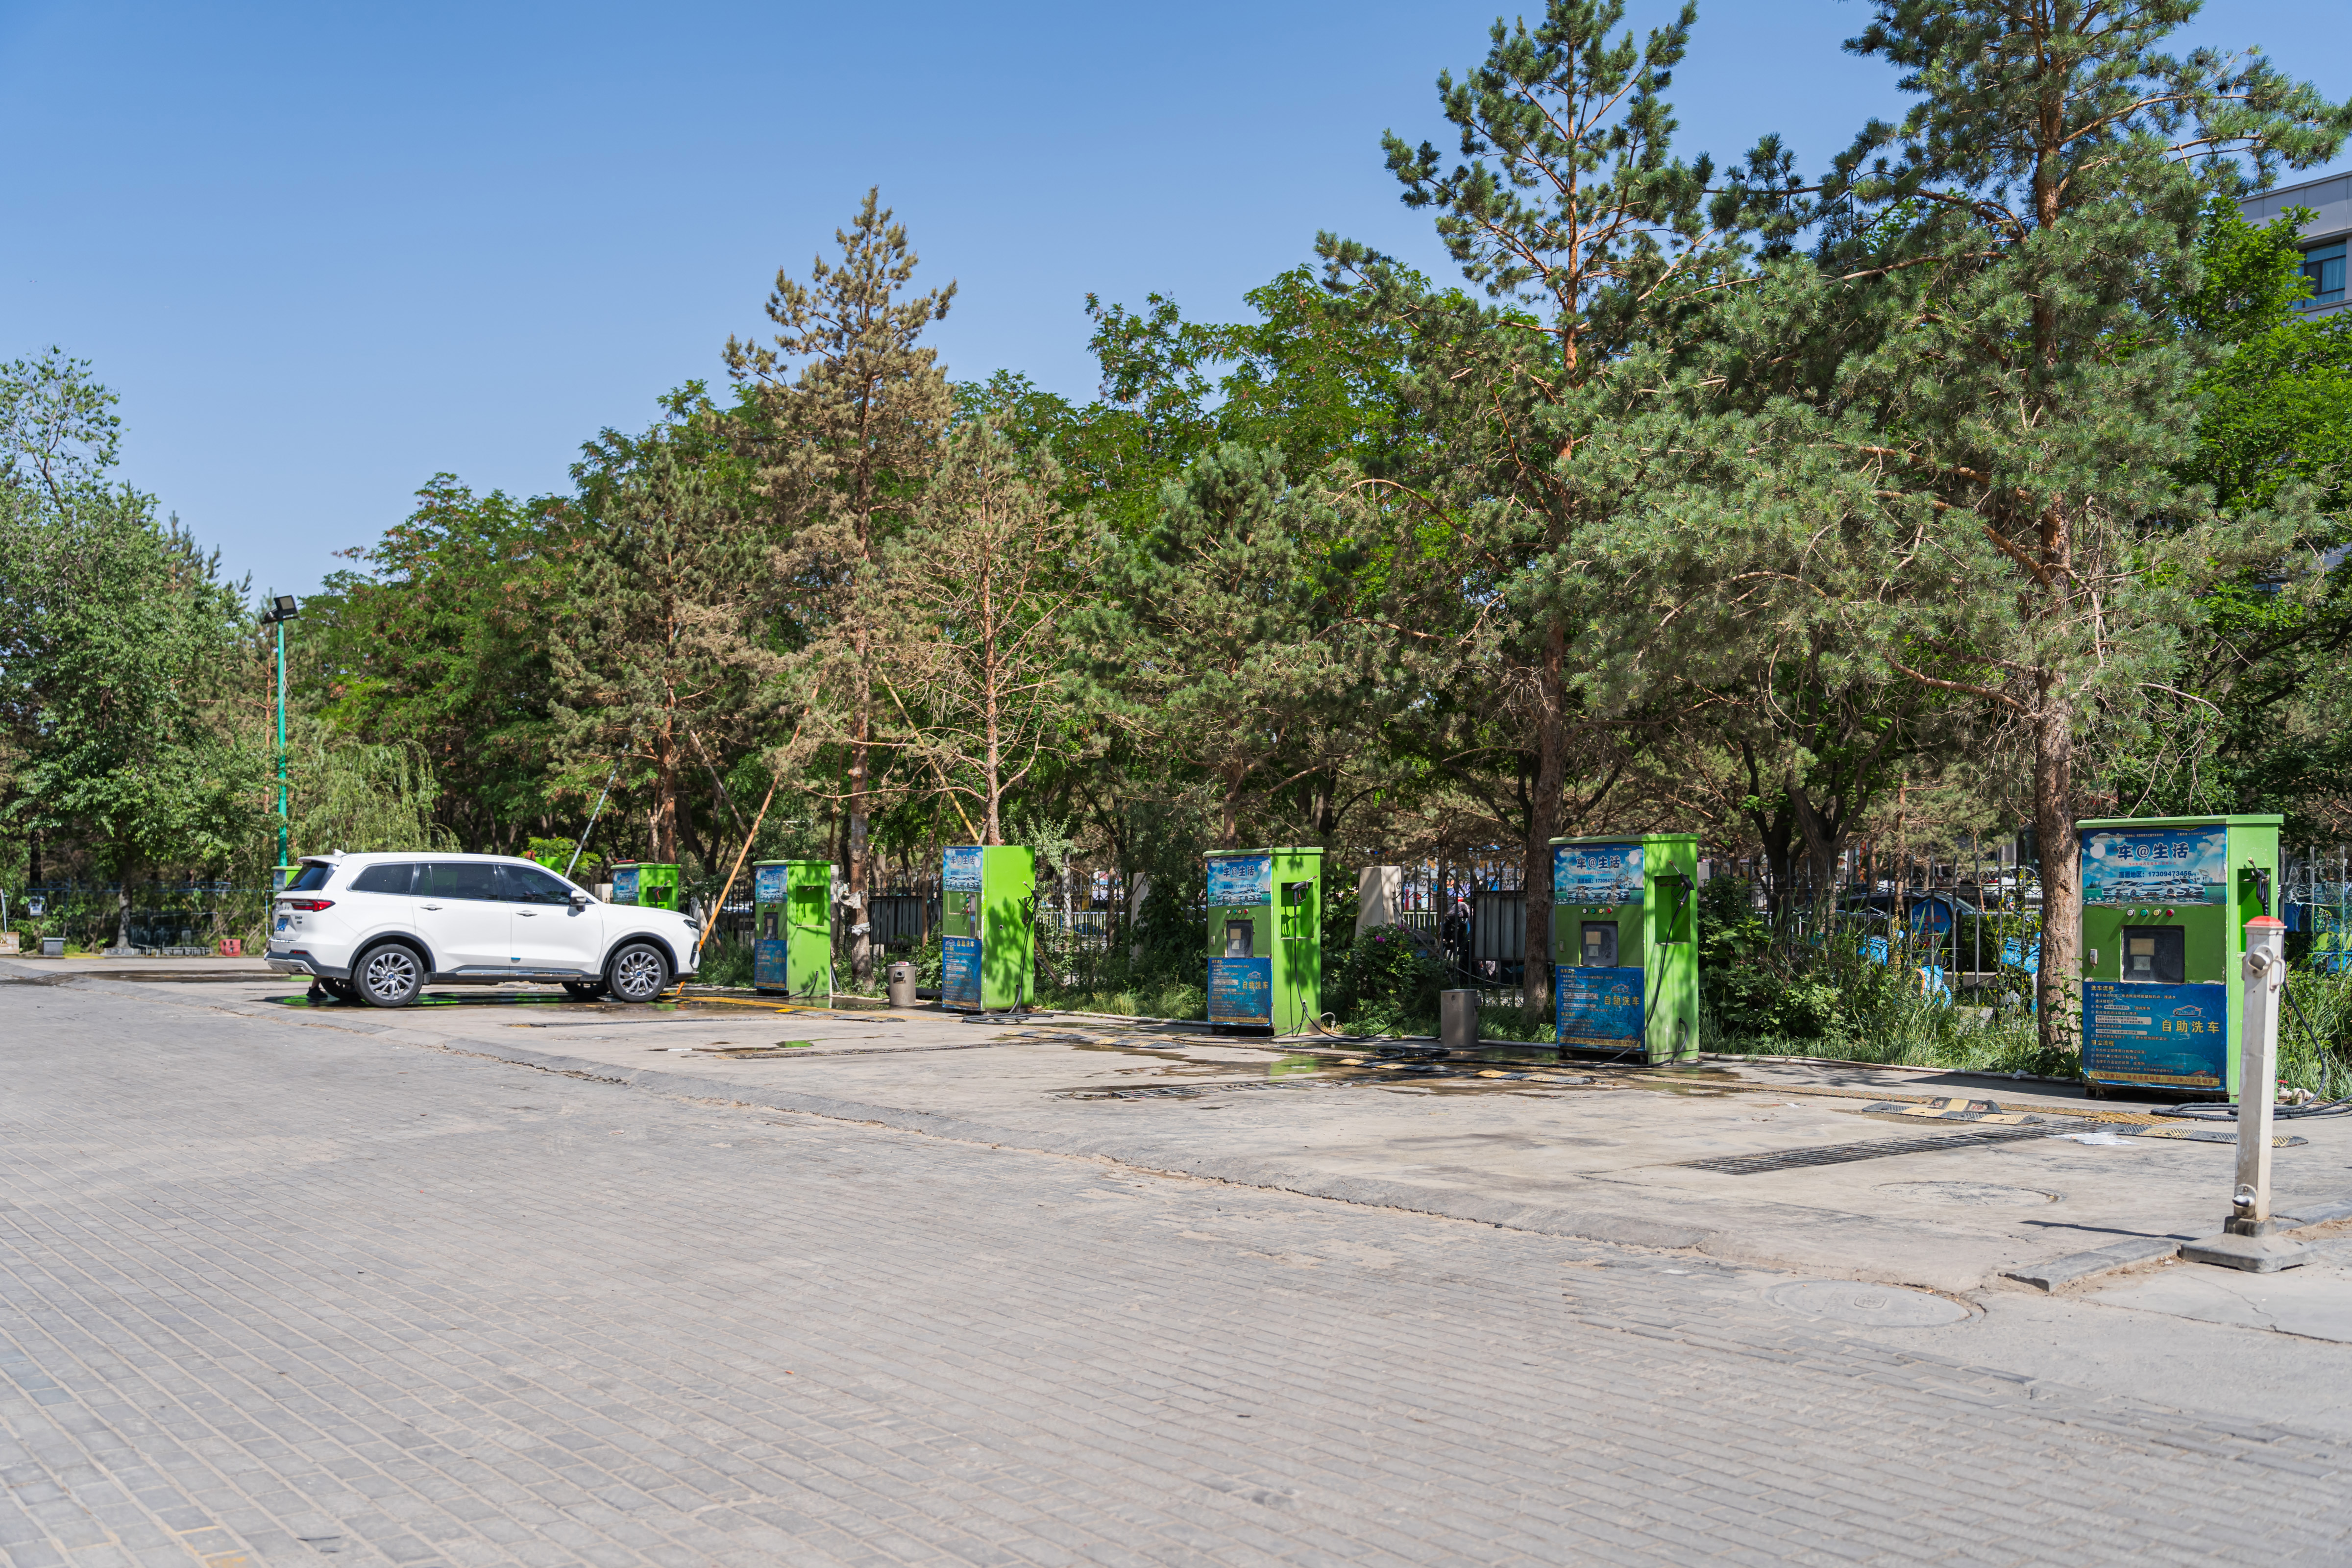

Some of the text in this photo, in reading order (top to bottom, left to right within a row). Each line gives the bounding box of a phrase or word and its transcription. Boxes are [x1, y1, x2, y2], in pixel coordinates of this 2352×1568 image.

[2117, 842, 2189, 860] 车@生活
[951, 855, 975, 865] 车@生活
[1576, 855, 1621, 870] 车@生活
[1223, 865, 1255, 877] 车@生活
[1242, 980, 1269, 989] 自助洗车
[1604, 995, 1640, 1006] 自助洗车
[2162, 1019, 2219, 1033] 自助洗车
